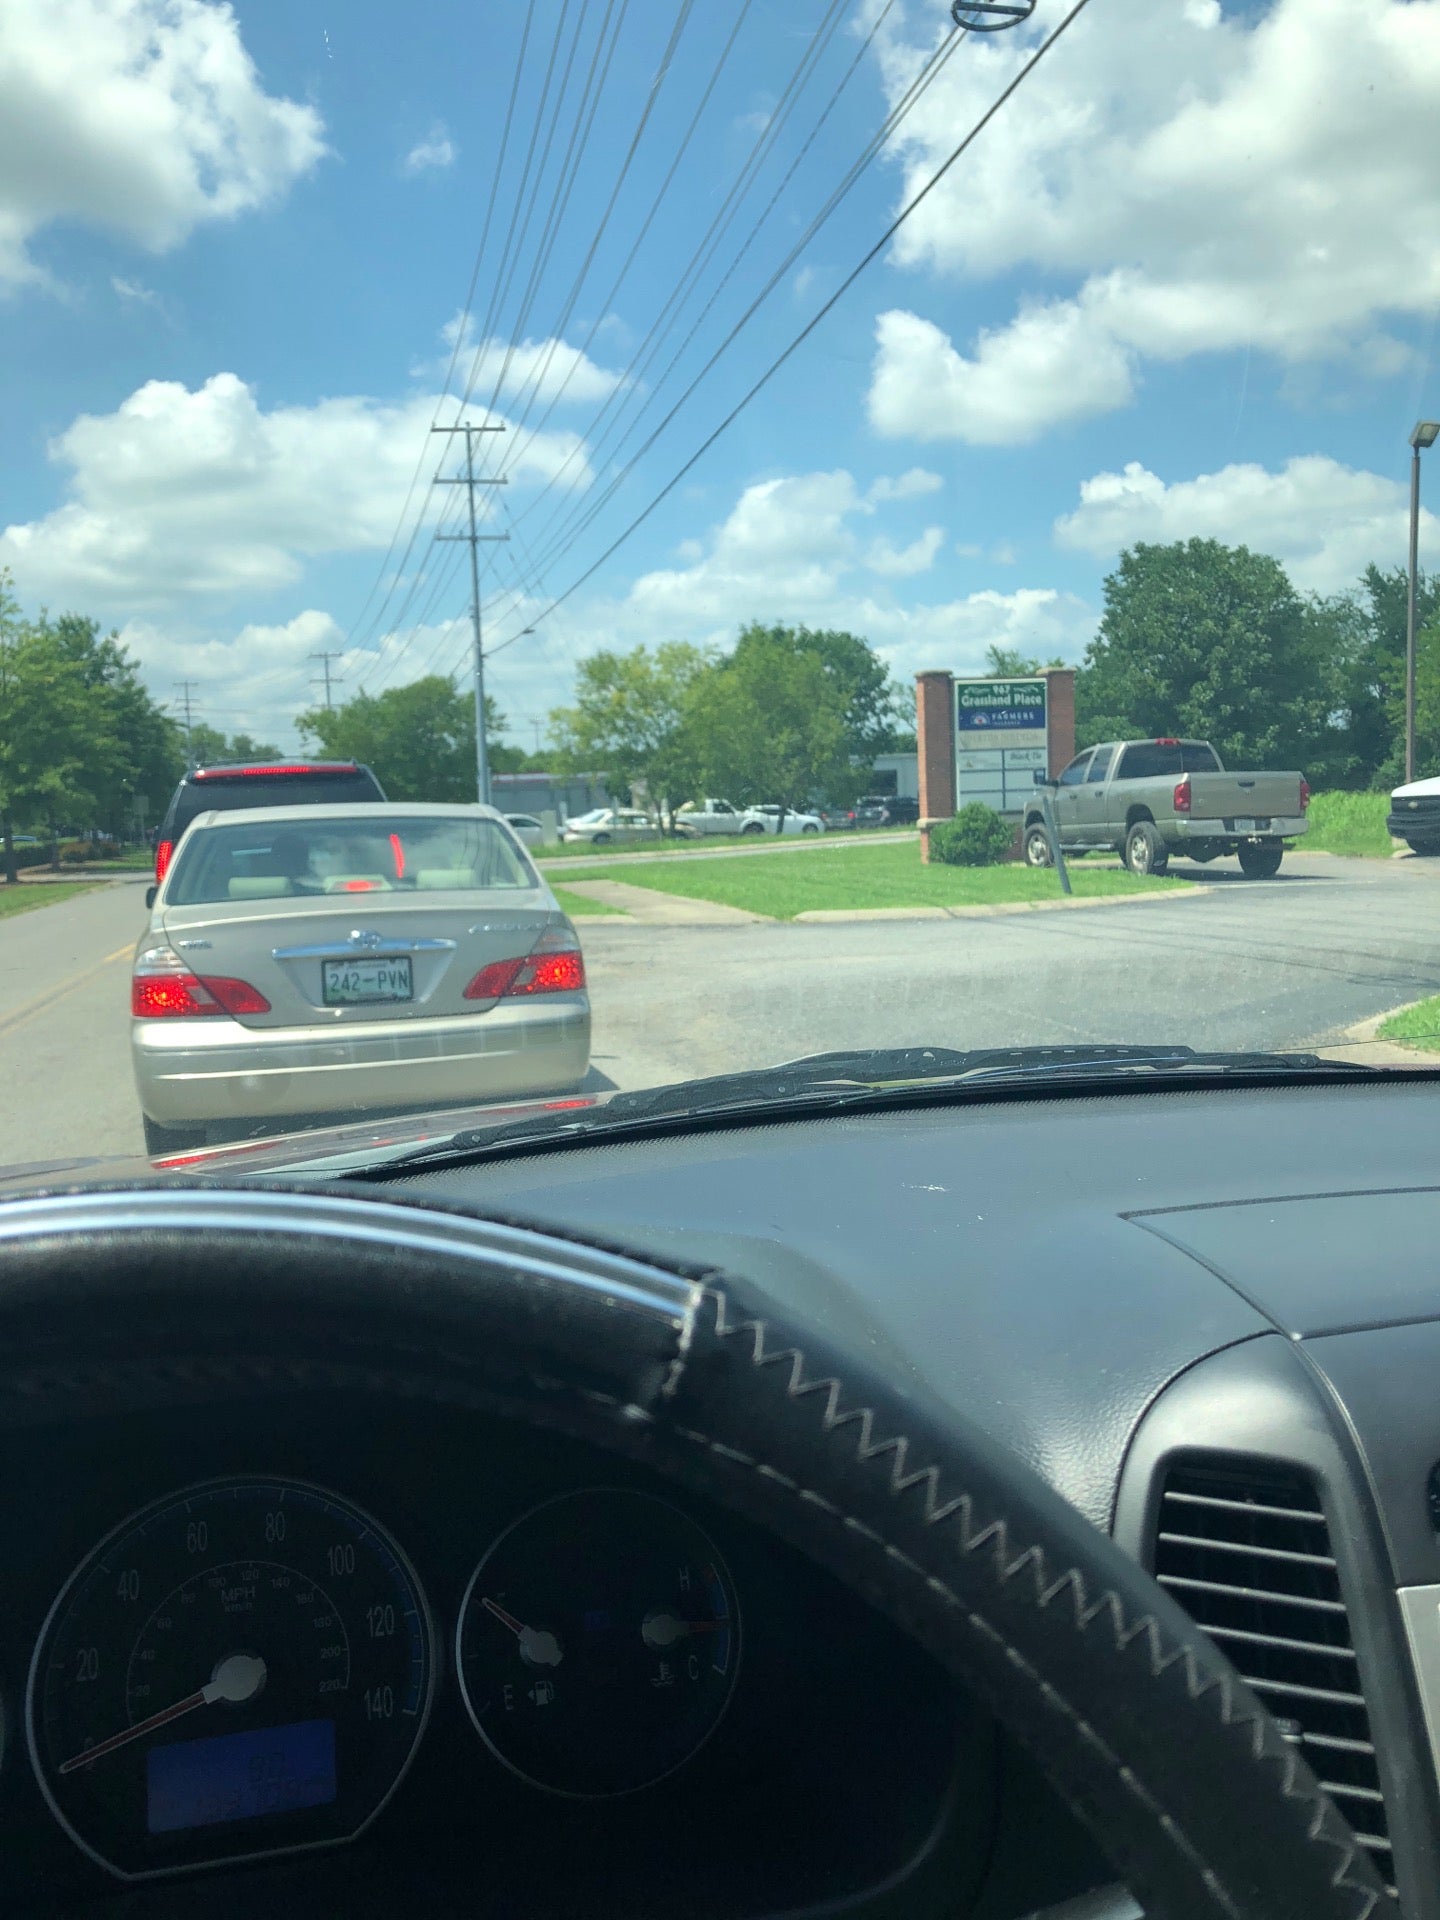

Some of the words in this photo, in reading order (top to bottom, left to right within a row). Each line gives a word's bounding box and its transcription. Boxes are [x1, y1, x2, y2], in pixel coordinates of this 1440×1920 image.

[961, 694, 1011, 707] Grassland
[1014, 693, 1042, 706] Place
[993, 684, 1011, 694] 967
[991, 711, 1034, 720] FARMERS
[330, 970, 408, 993] 242-PVN
[186, 1521, 208, 1553] 60
[266, 1511, 286, 1543] 80
[327, 1544, 356, 1577] 100
[116, 1569, 140, 1602] 40
[221, 1586, 256, 1603] MPH
[366, 1604, 395, 1638] 120
[76, 1647, 100, 1682] 20
[363, 1687, 394, 1721] 140
